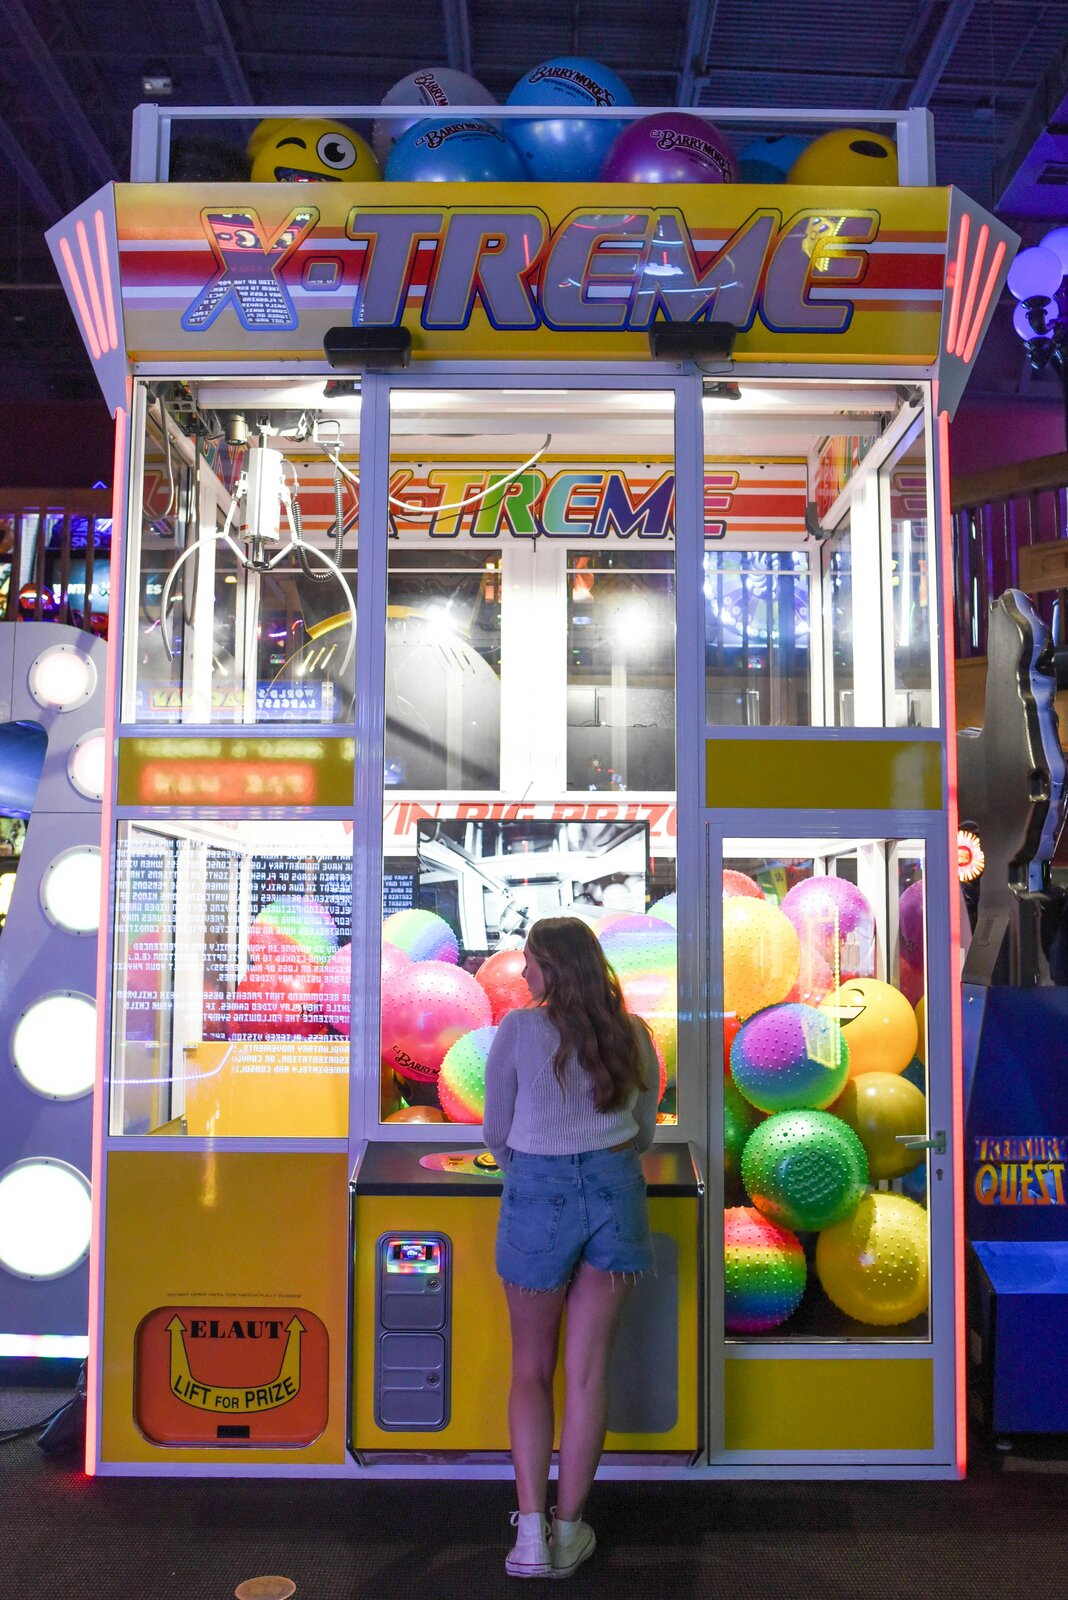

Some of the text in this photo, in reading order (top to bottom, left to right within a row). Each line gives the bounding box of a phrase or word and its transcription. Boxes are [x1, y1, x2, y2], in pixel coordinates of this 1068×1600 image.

[181, 204, 882, 334] X-TREME
[975, 1163, 1065, 1206] QUEST
[190, 1320, 283, 1339] ELAUT
[173, 1375, 297, 1408] LIFT FOR PRIZE
